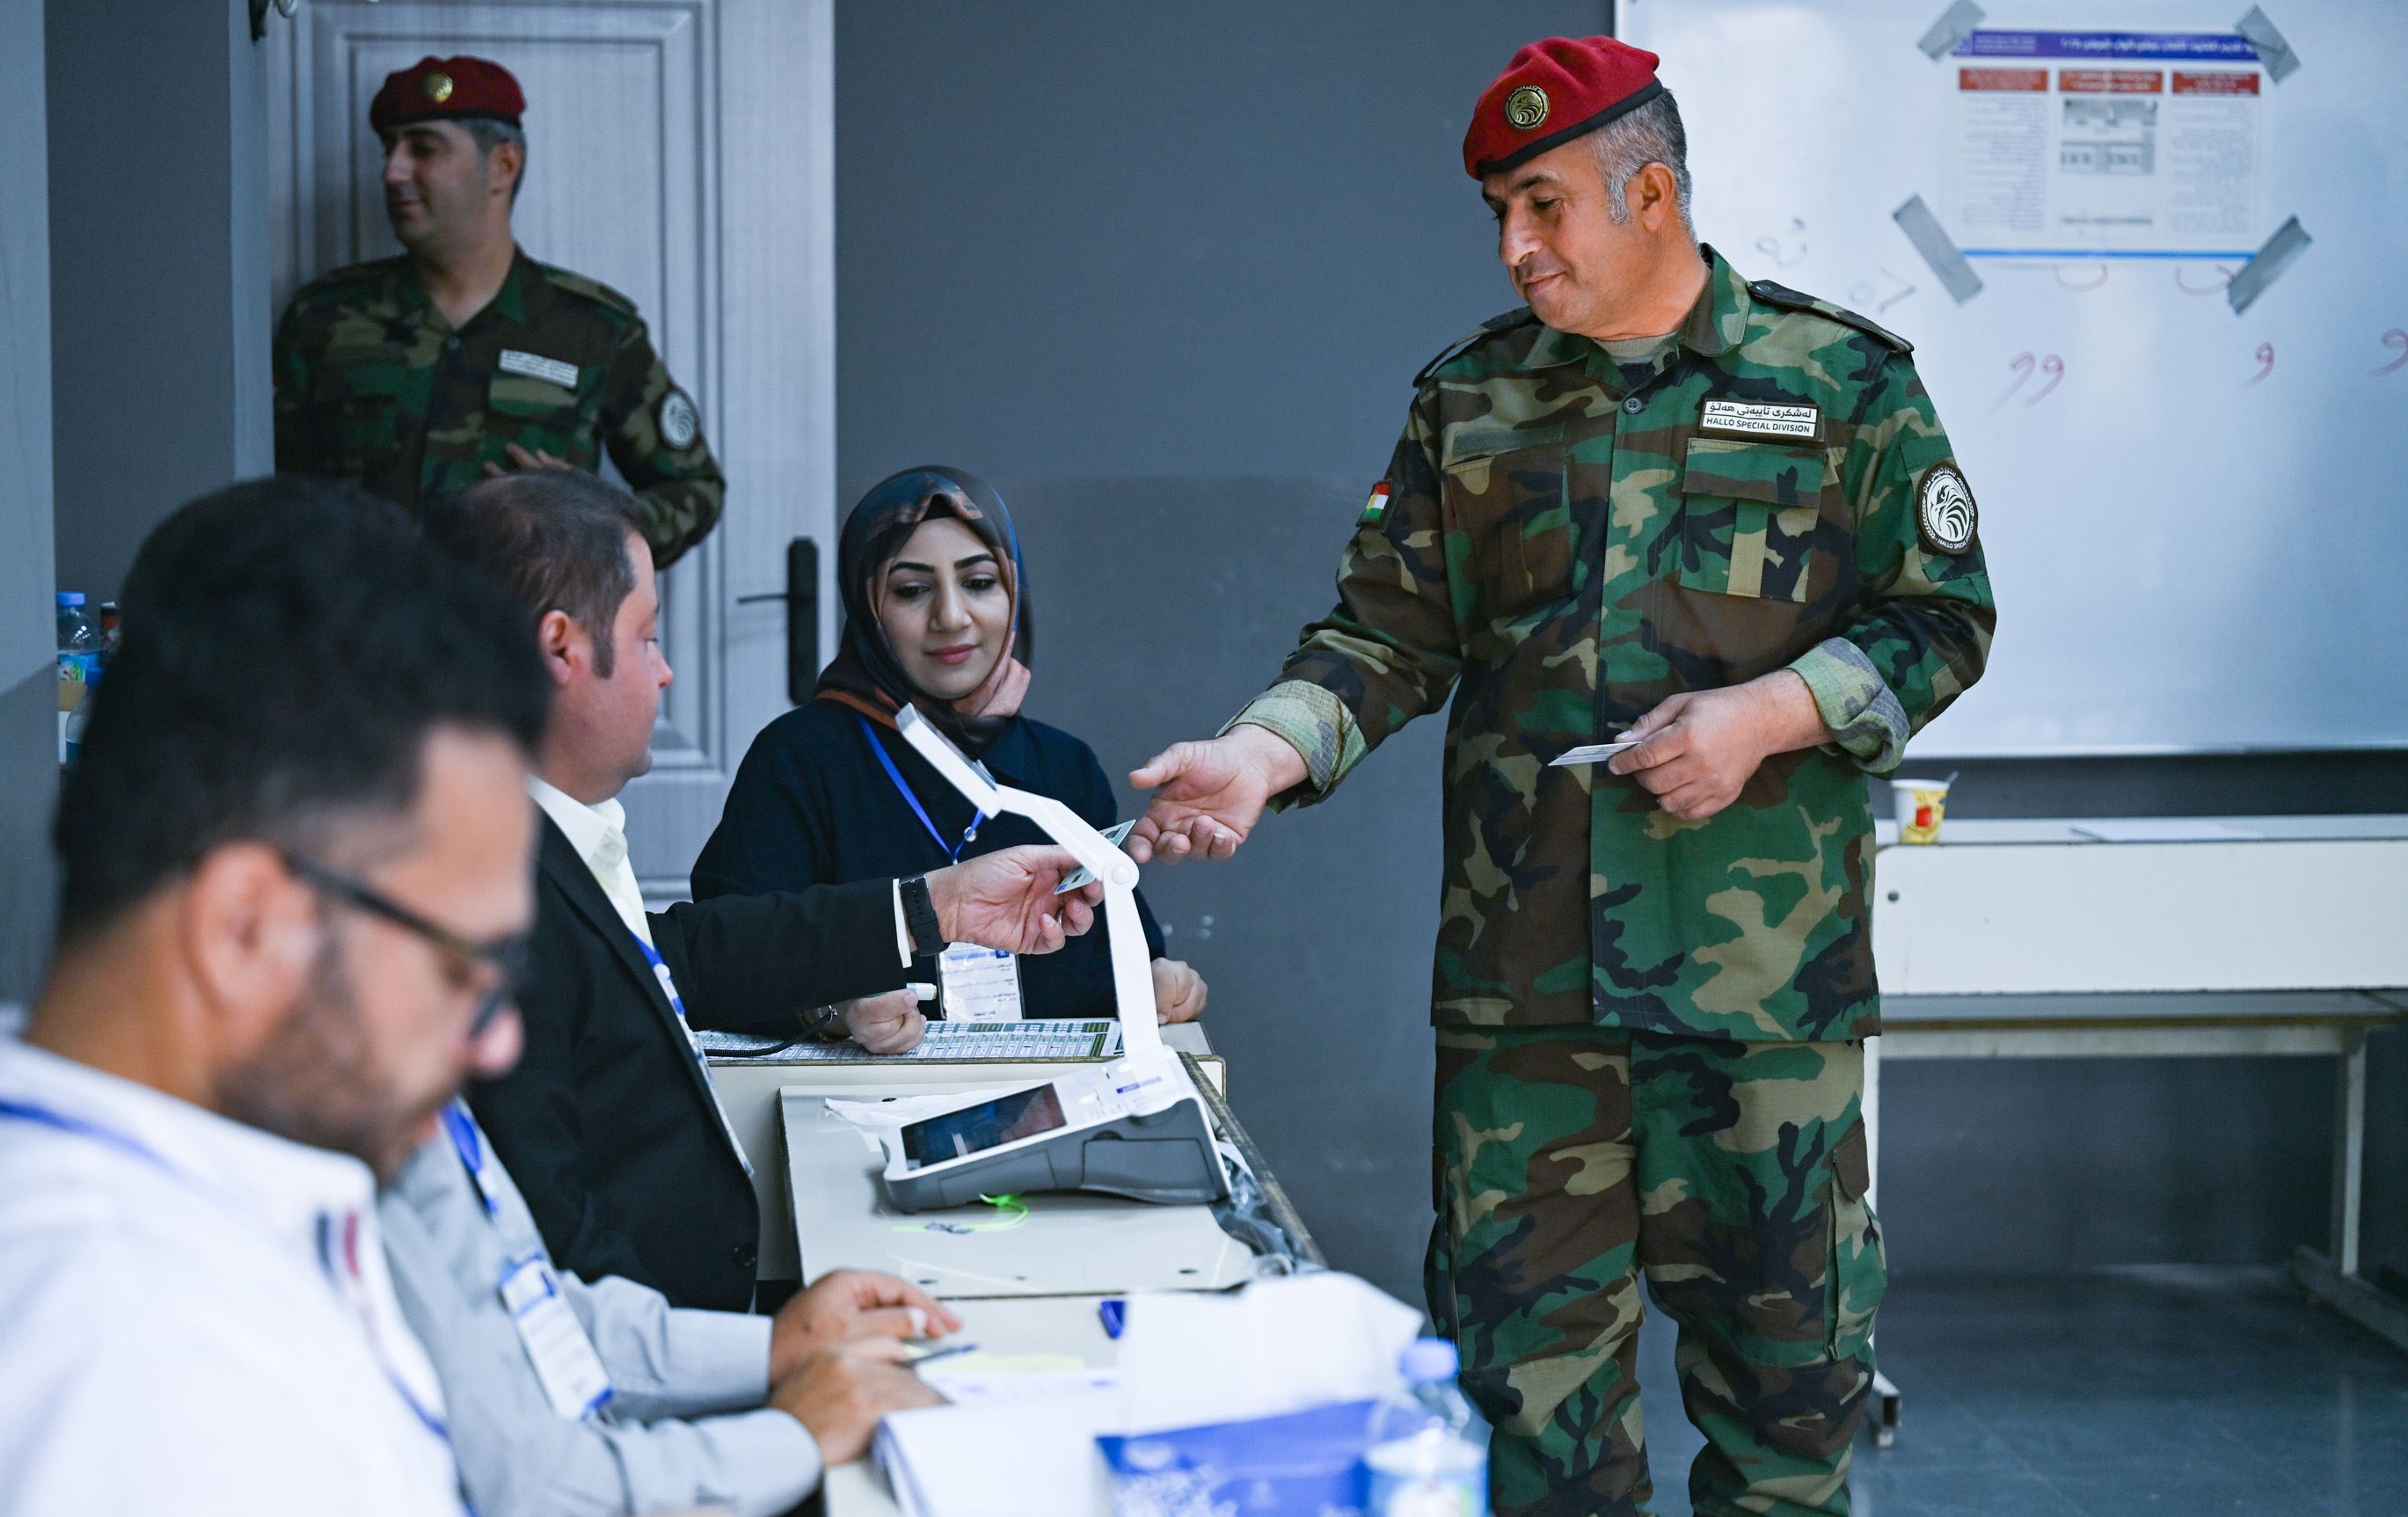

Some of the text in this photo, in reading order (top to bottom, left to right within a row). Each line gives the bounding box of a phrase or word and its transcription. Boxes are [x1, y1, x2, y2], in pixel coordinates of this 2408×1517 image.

[1706, 417, 1810, 433] HALLO SPECIAL DIVISION
[1937, 538, 1952, 549] HALLO
